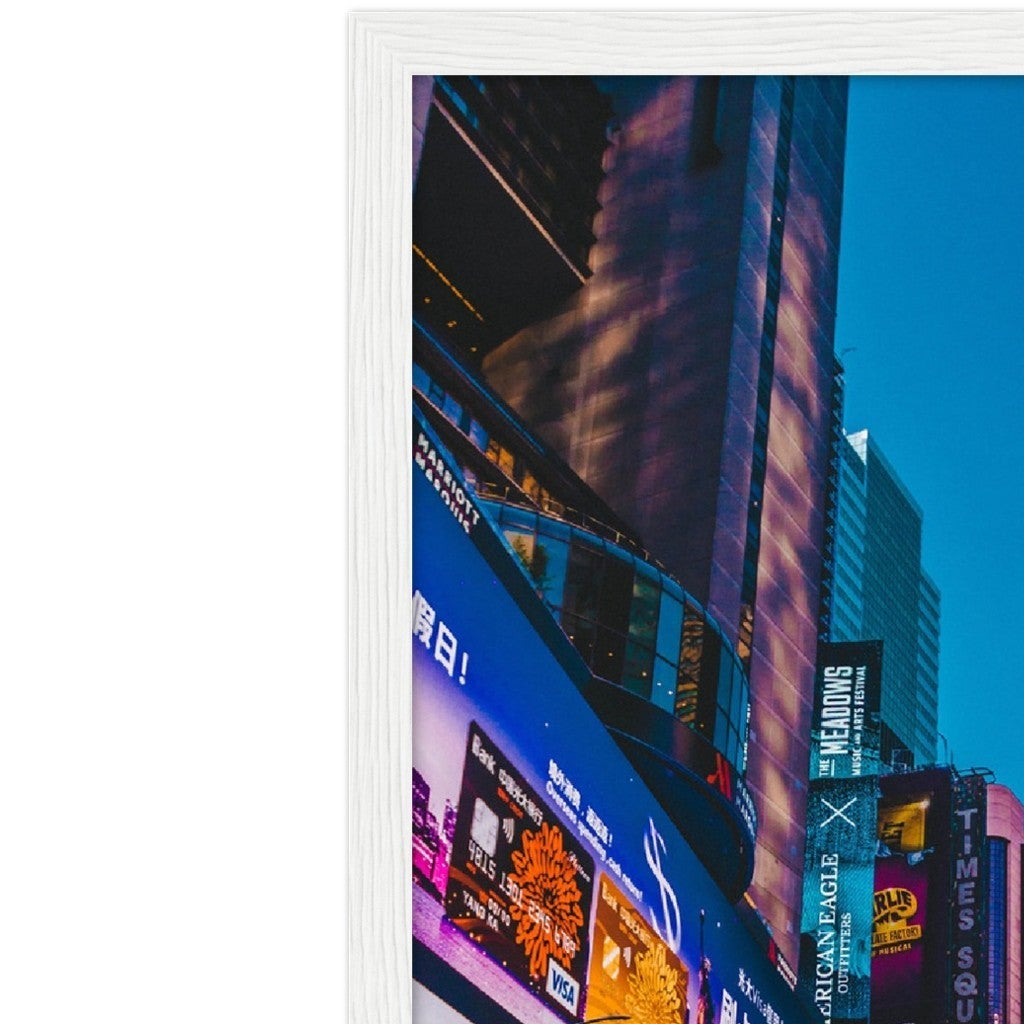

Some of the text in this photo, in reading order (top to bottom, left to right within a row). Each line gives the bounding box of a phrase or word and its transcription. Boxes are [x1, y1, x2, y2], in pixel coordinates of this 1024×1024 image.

[854, 666, 867, 705] FESTIVAL
[819, 665, 853, 777] THE MEADOWS
[853, 707, 864, 731] ARTS
[852, 747, 862, 776] MUSIC
[955, 808, 979, 931] TIMES
[819, 853, 838, 926] EAGLE
[838, 912, 852, 994] OUTFITTERS
[889, 926, 919, 941] FACTORY
[551, 968, 575, 1006] VISA
